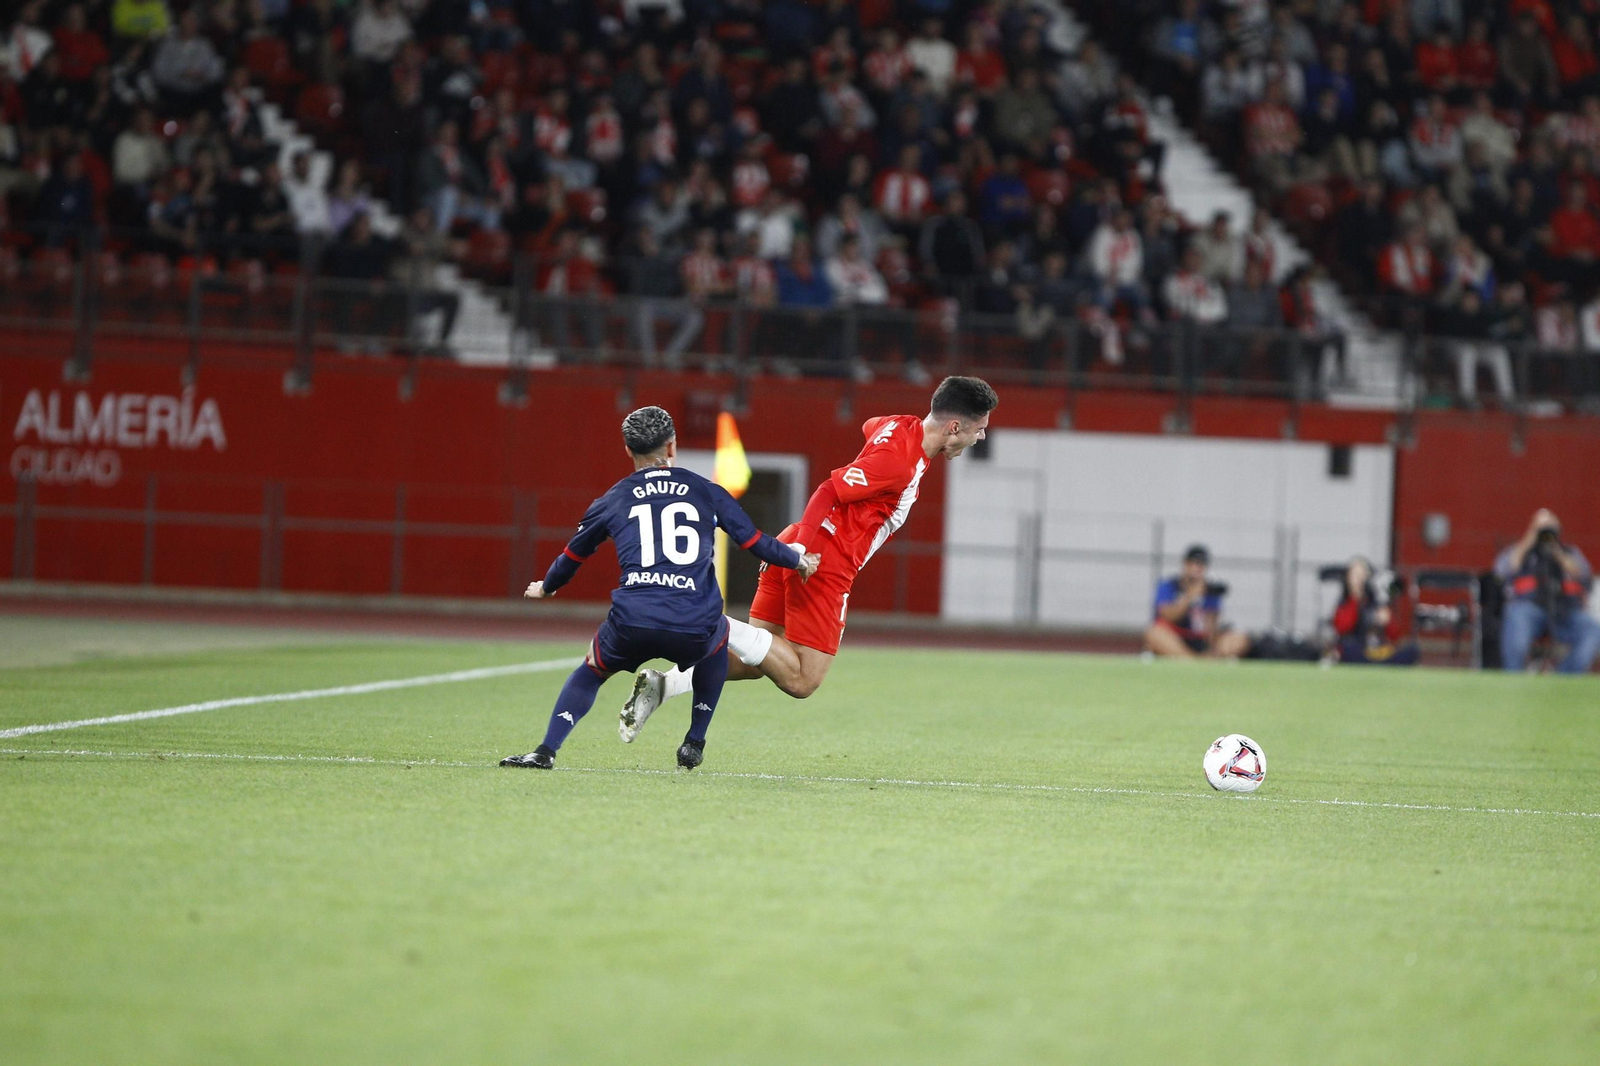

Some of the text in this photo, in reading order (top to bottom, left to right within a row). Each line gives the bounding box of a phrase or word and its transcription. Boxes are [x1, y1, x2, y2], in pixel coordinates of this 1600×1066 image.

[14, 386, 227, 450] ALMERÍA
[632, 480, 690, 499] GAUTO
[628, 501, 700, 568] 16
[626, 571, 696, 591] ABANCA
